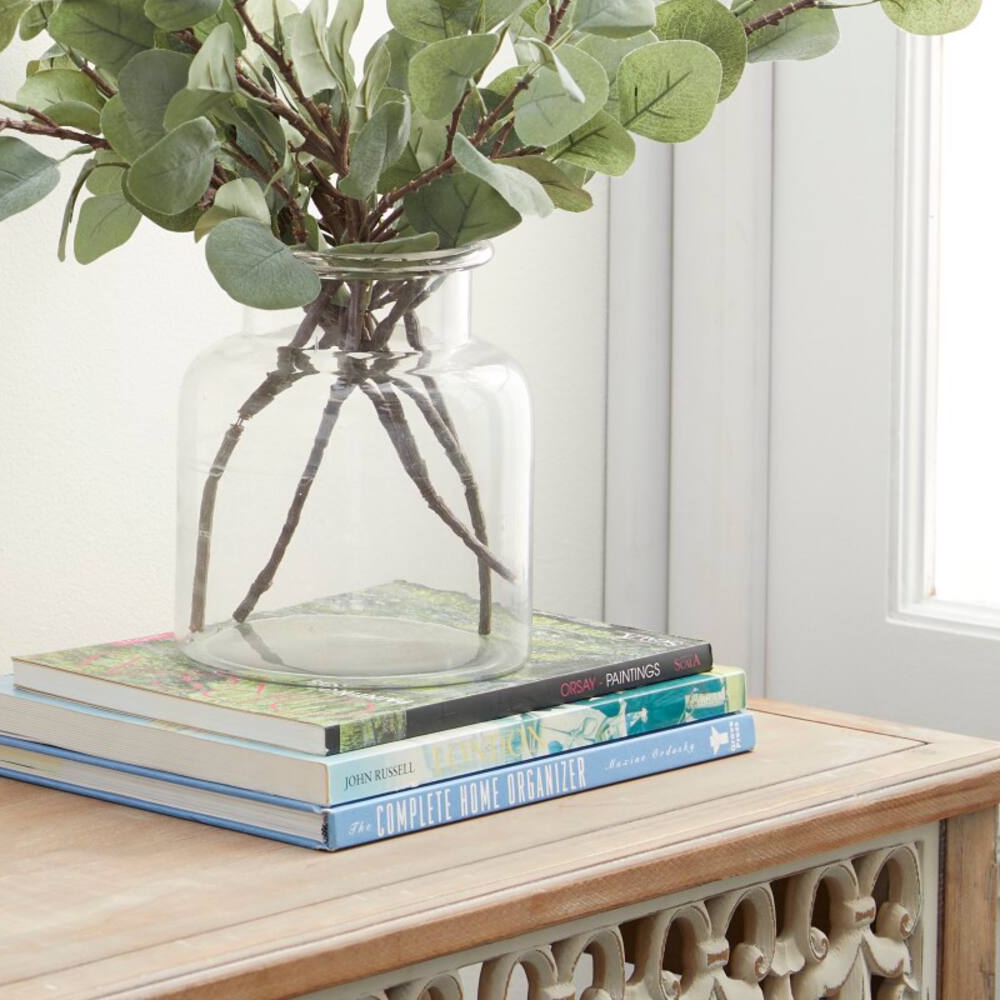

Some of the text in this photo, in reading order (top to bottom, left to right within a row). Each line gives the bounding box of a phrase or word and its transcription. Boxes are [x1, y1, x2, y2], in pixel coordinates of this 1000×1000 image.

[560, 675, 596, 698] ORSAY
[605, 662, 661, 688] PAINTINGS
[344, 761, 416, 791] JOHN RUSSELL
[347, 756, 587, 838] The COMPLETE HOME ORGANIZER
